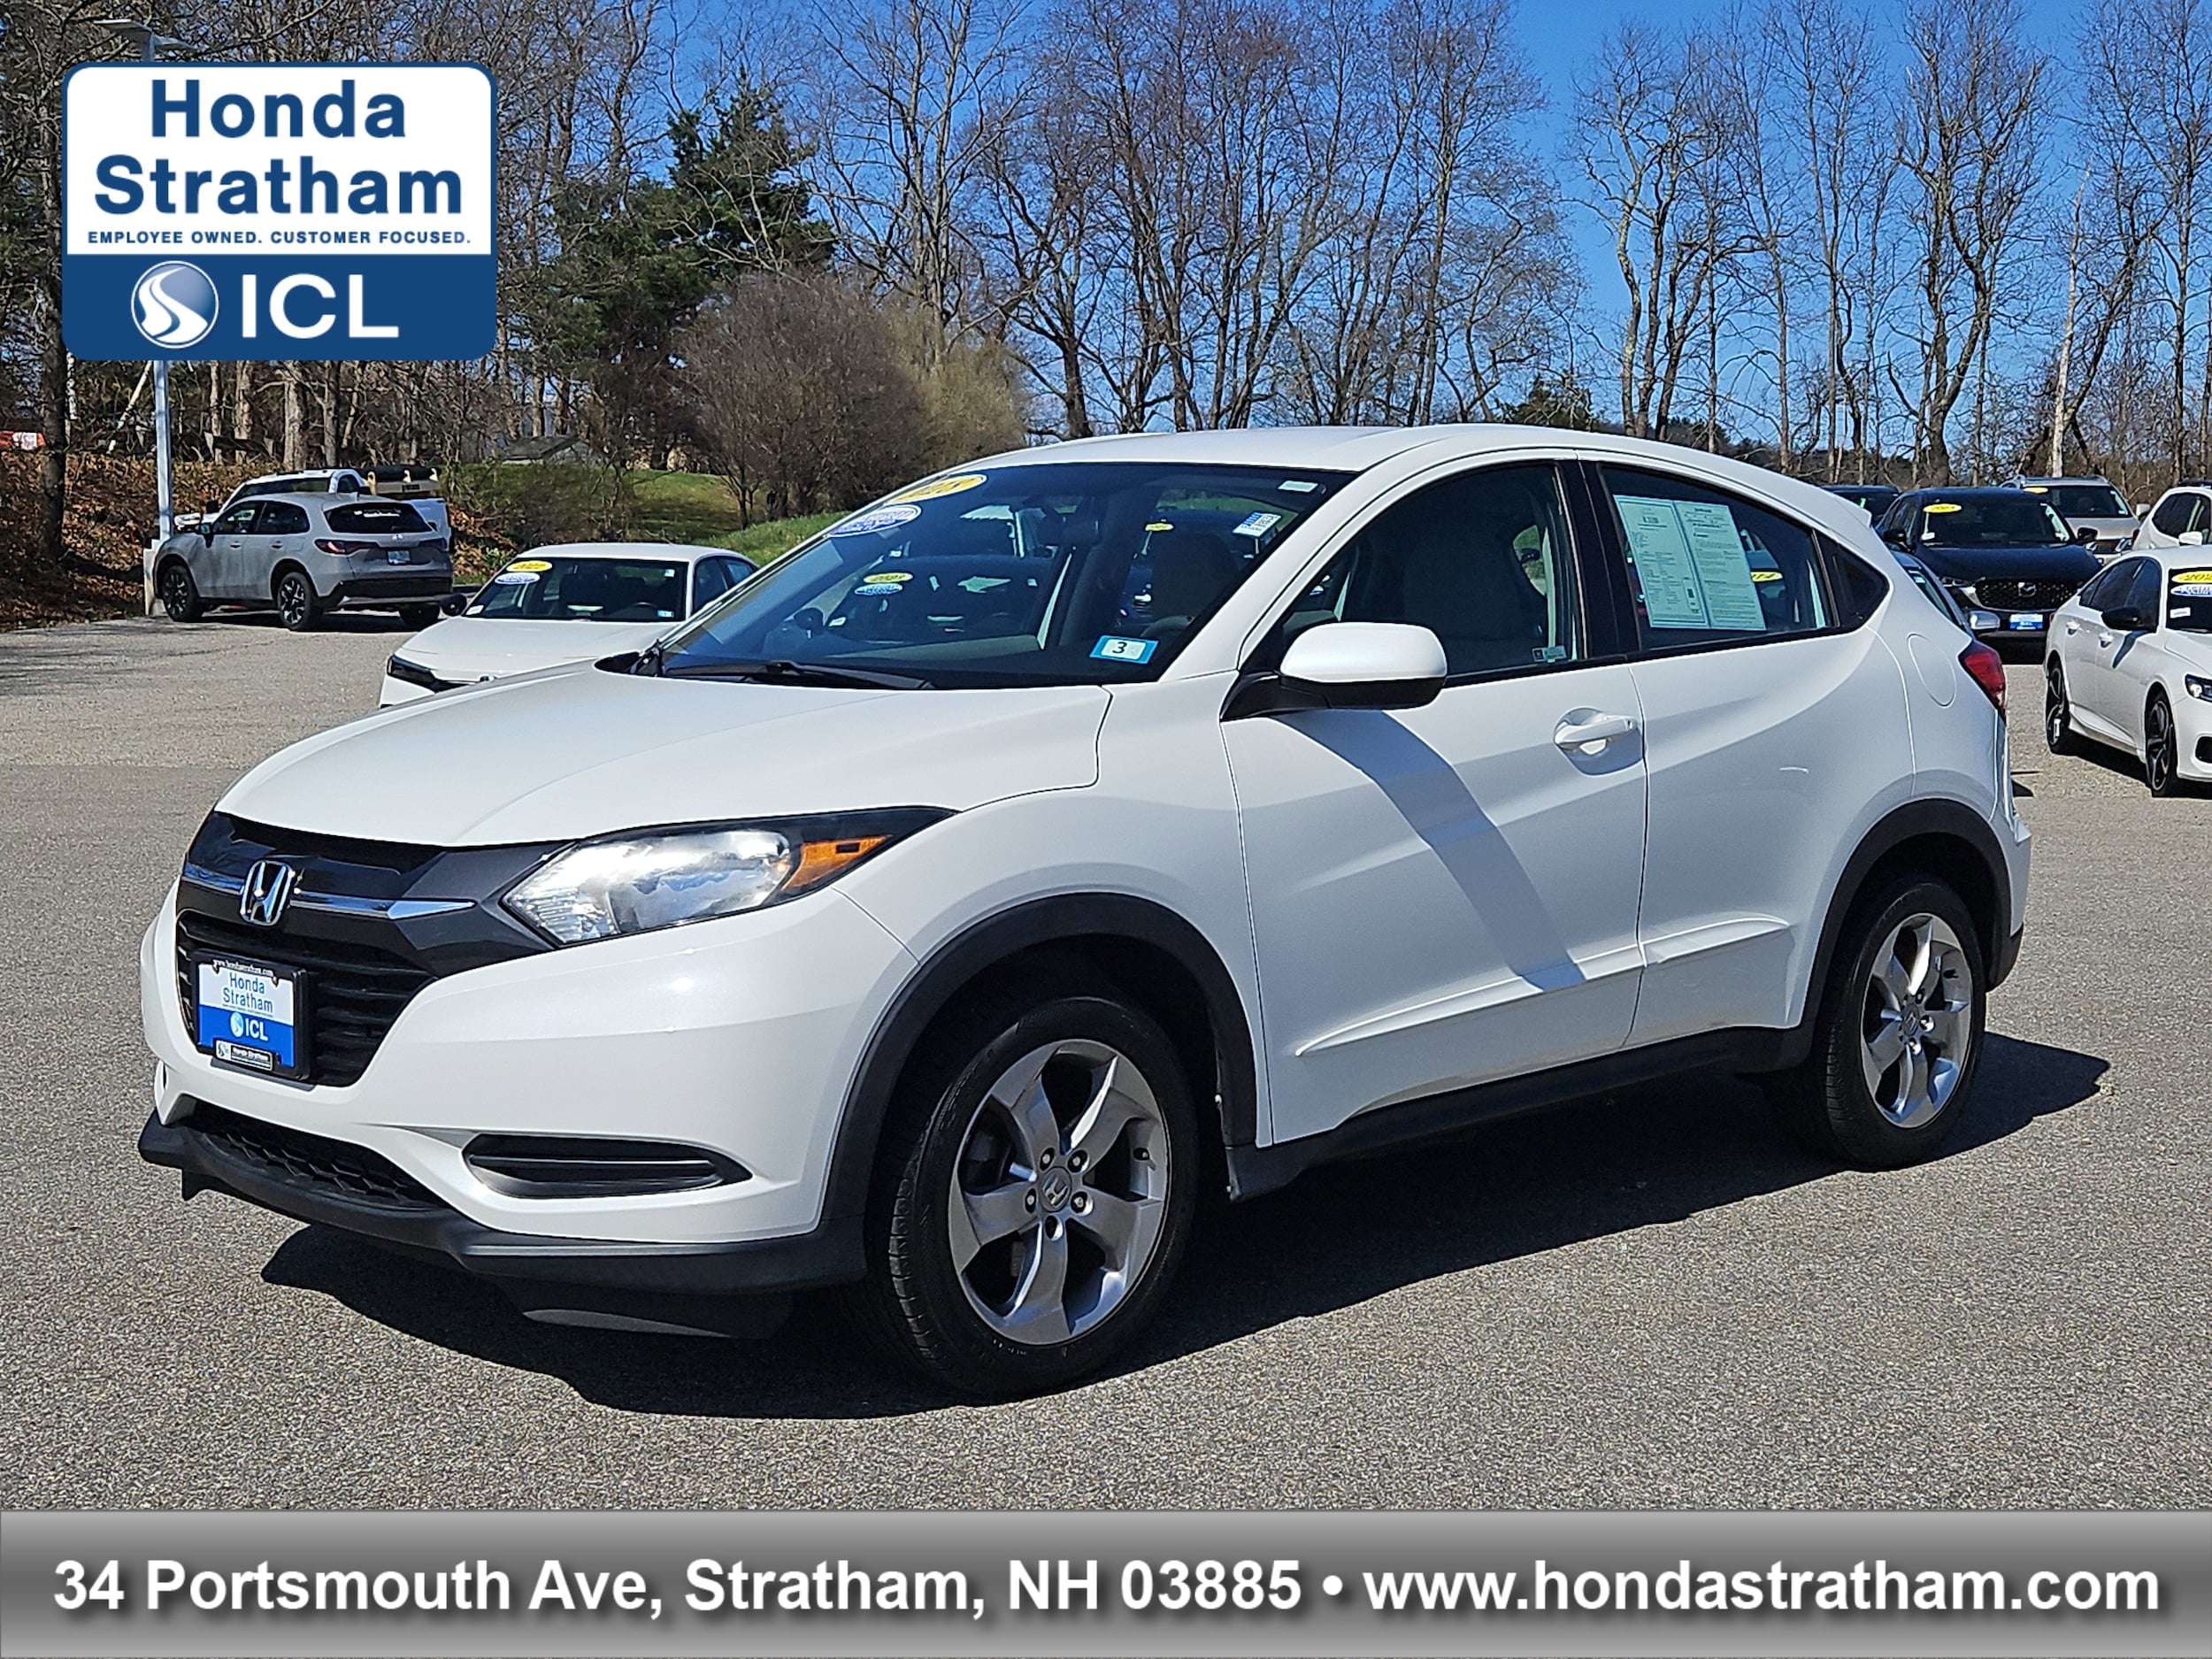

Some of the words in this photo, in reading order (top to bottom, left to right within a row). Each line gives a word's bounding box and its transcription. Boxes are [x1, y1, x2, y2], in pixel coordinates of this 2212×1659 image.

[1112, 641, 1127, 654] 3
[229, 972, 265, 995] Honda
[222, 987, 273, 1013] Stratham
[244, 1018, 269, 1041] ICL
